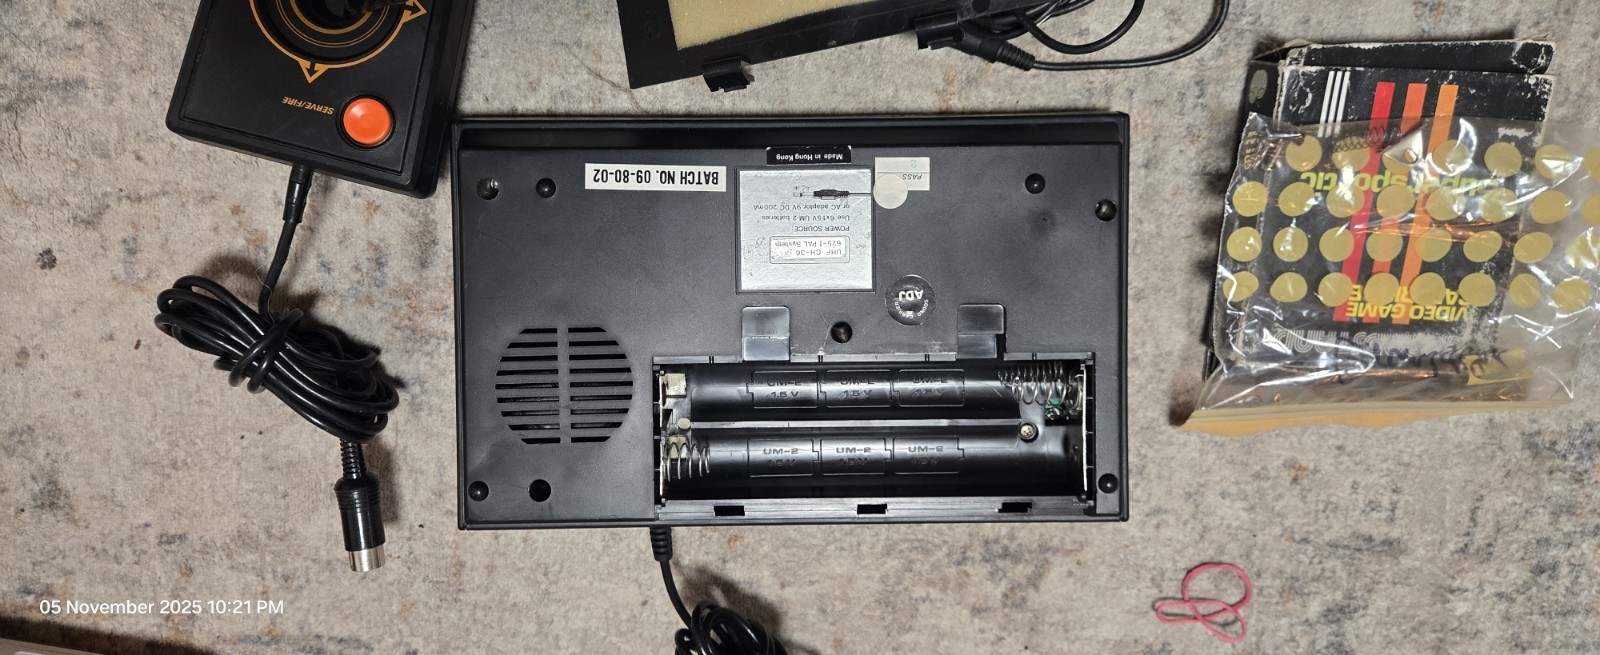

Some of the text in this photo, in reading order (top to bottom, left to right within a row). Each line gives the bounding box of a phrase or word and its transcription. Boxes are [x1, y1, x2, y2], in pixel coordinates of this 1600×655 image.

[282, 96, 334, 115] SERVE/FIRE
[593, 169, 719, 185] BATCH NO. 09-80-02
[898, 290, 923, 301] ADJ
[917, 299, 928, 317] SOUND
[1346, 302, 1468, 321] VIDEO GAME
